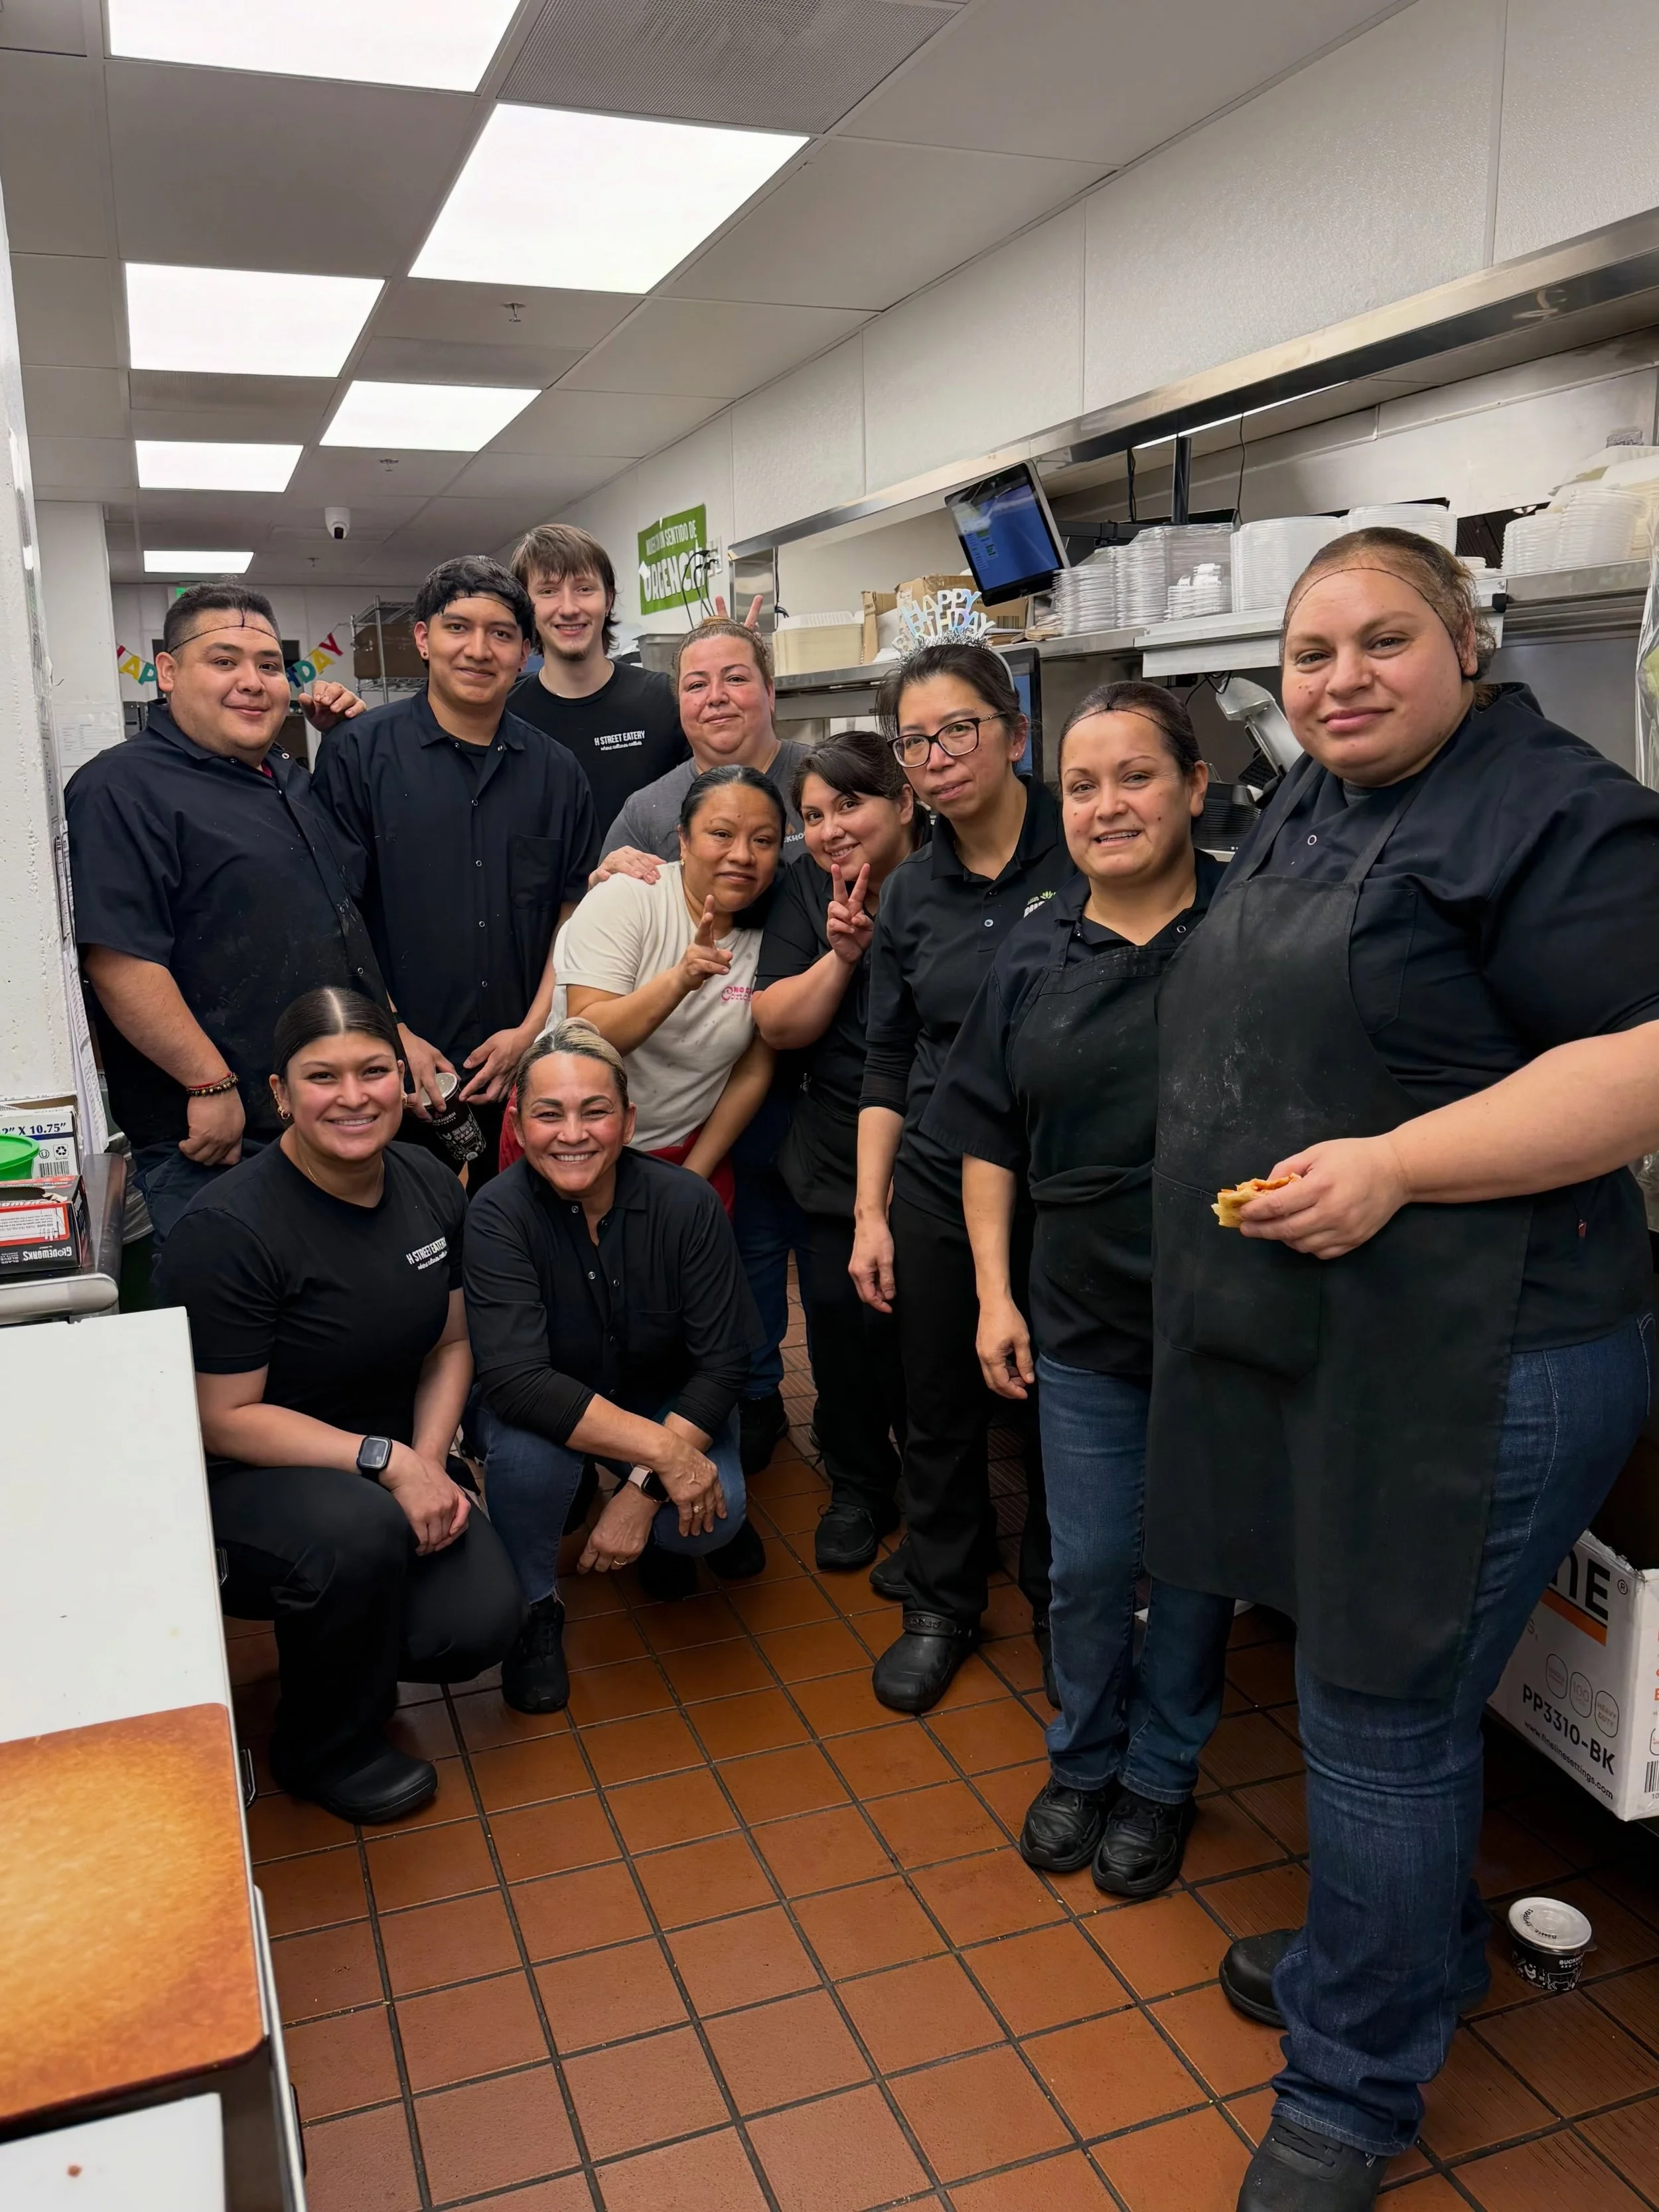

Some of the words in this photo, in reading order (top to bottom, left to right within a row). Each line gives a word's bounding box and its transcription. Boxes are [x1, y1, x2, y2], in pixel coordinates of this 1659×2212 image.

[688, 520, 697, 540] DE
[901, 588, 982, 625] HAPPY
[594, 737, 600, 746] H
[600, 733, 622, 745] STREET
[622, 730, 645, 741] EATERY
[18, 1126, 26, 1136] X
[30, 1122, 66, 1134] 10.75"
[23, 1246, 72, 1262] GLOVEWORKS
[405, 1253, 415, 1265] H
[411, 1244, 433, 1262] STREET
[1523, 1683, 1615, 1776] PP3310-BK
